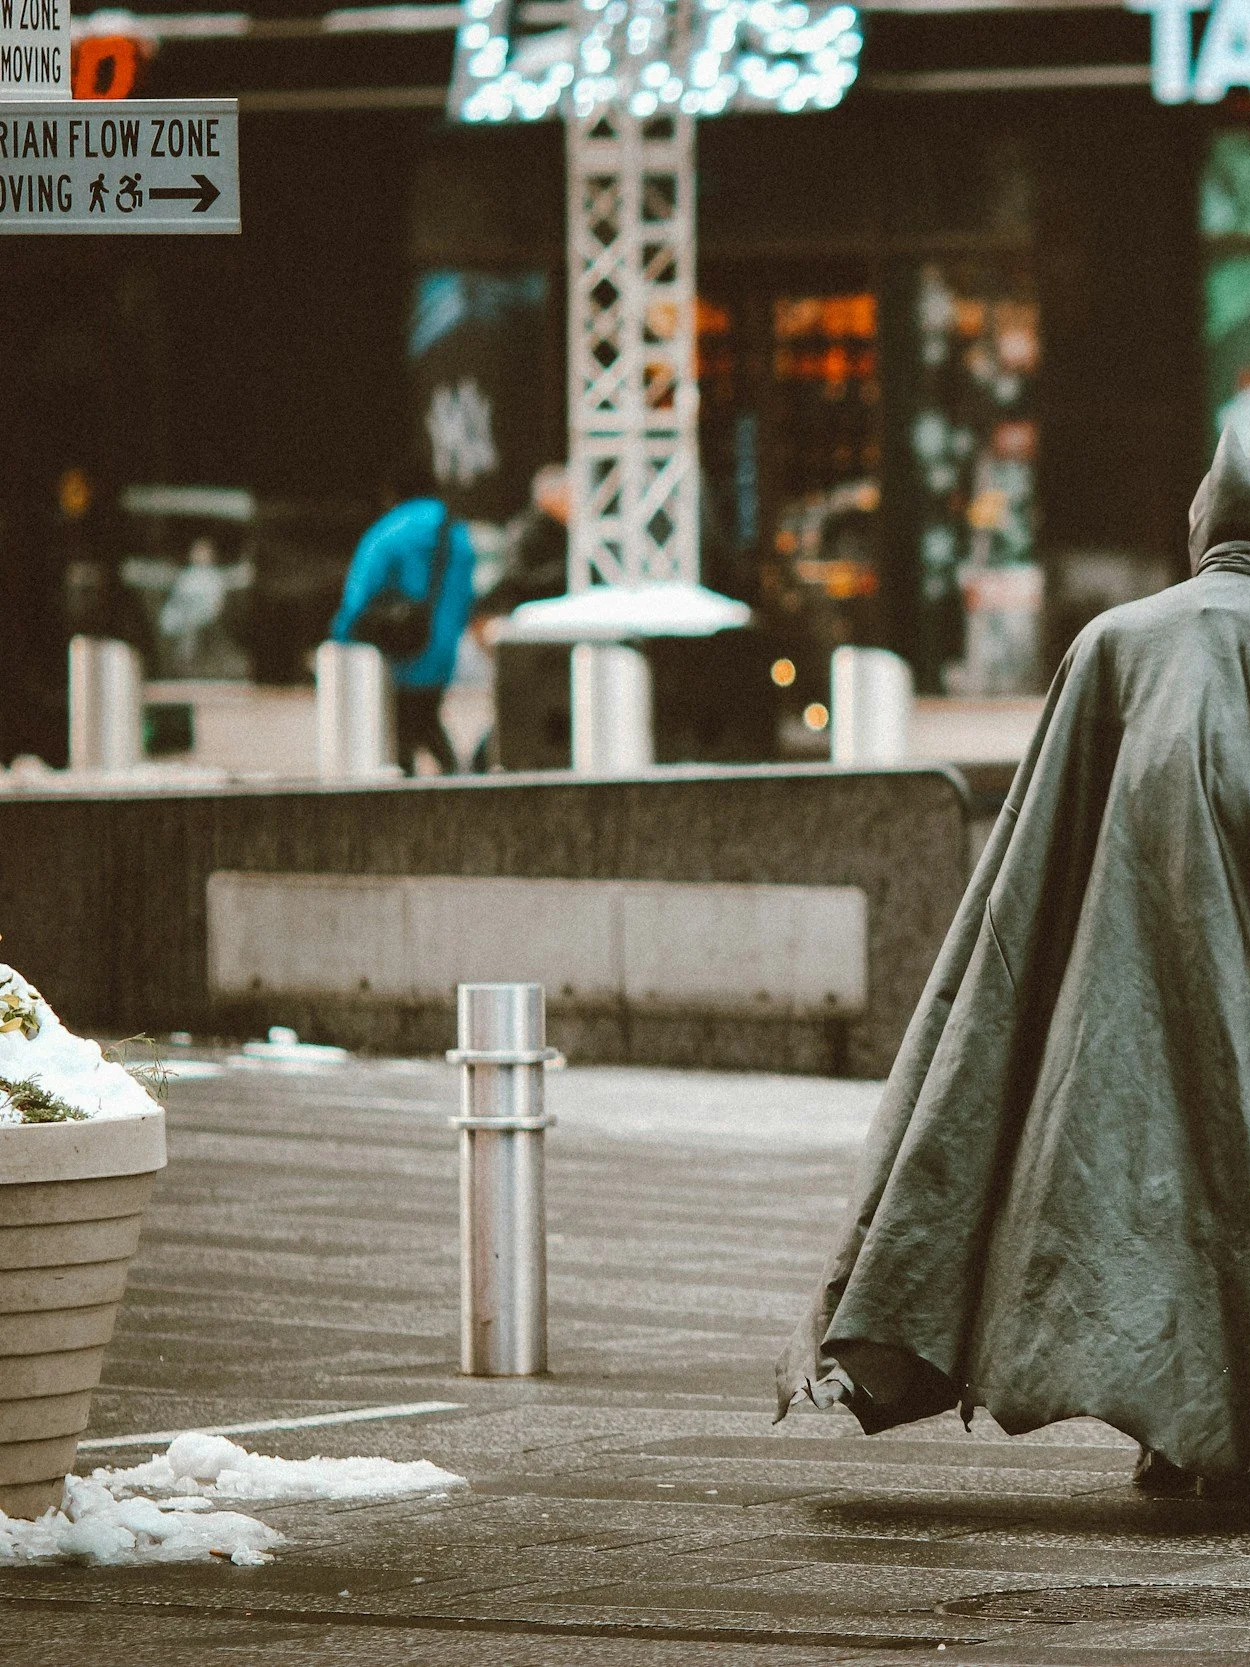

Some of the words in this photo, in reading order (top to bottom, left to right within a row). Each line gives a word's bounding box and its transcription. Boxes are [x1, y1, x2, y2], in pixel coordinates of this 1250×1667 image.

[20, 0, 61, 30] ZONE
[1, 45, 61, 83] MOVING
[69, 119, 140, 158] FLOW
[150, 119, 220, 157] ZONE
